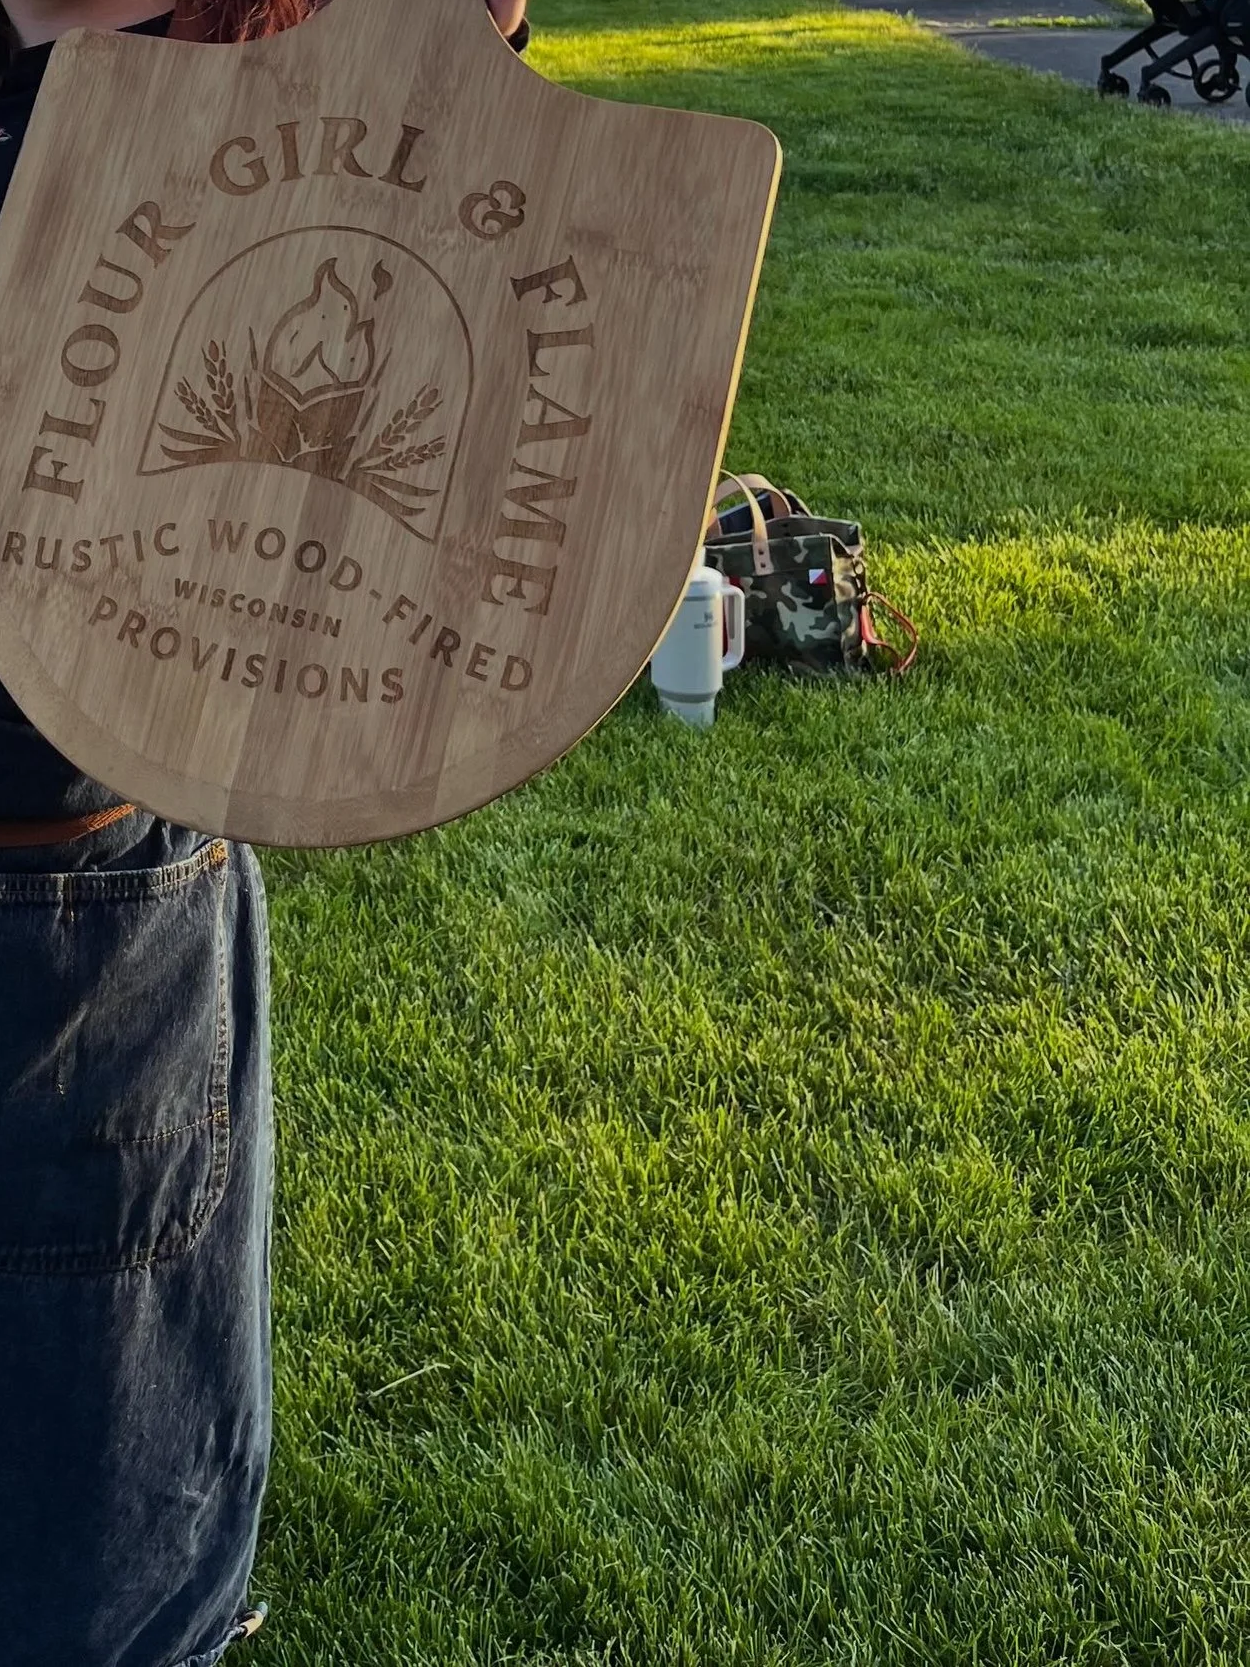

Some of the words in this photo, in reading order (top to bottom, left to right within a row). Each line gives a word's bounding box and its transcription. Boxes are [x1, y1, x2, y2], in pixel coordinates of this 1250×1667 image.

[208, 116, 428, 197] GIRL
[458, 180, 527, 240] &
[21, 200, 197, 504] FLOUR
[480, 254, 596, 617] FLAME
[1, 522, 180, 573] RUSTIC
[174, 578, 343, 638] WISCONSIN
[88, 595, 404, 704] PROVISIONS
